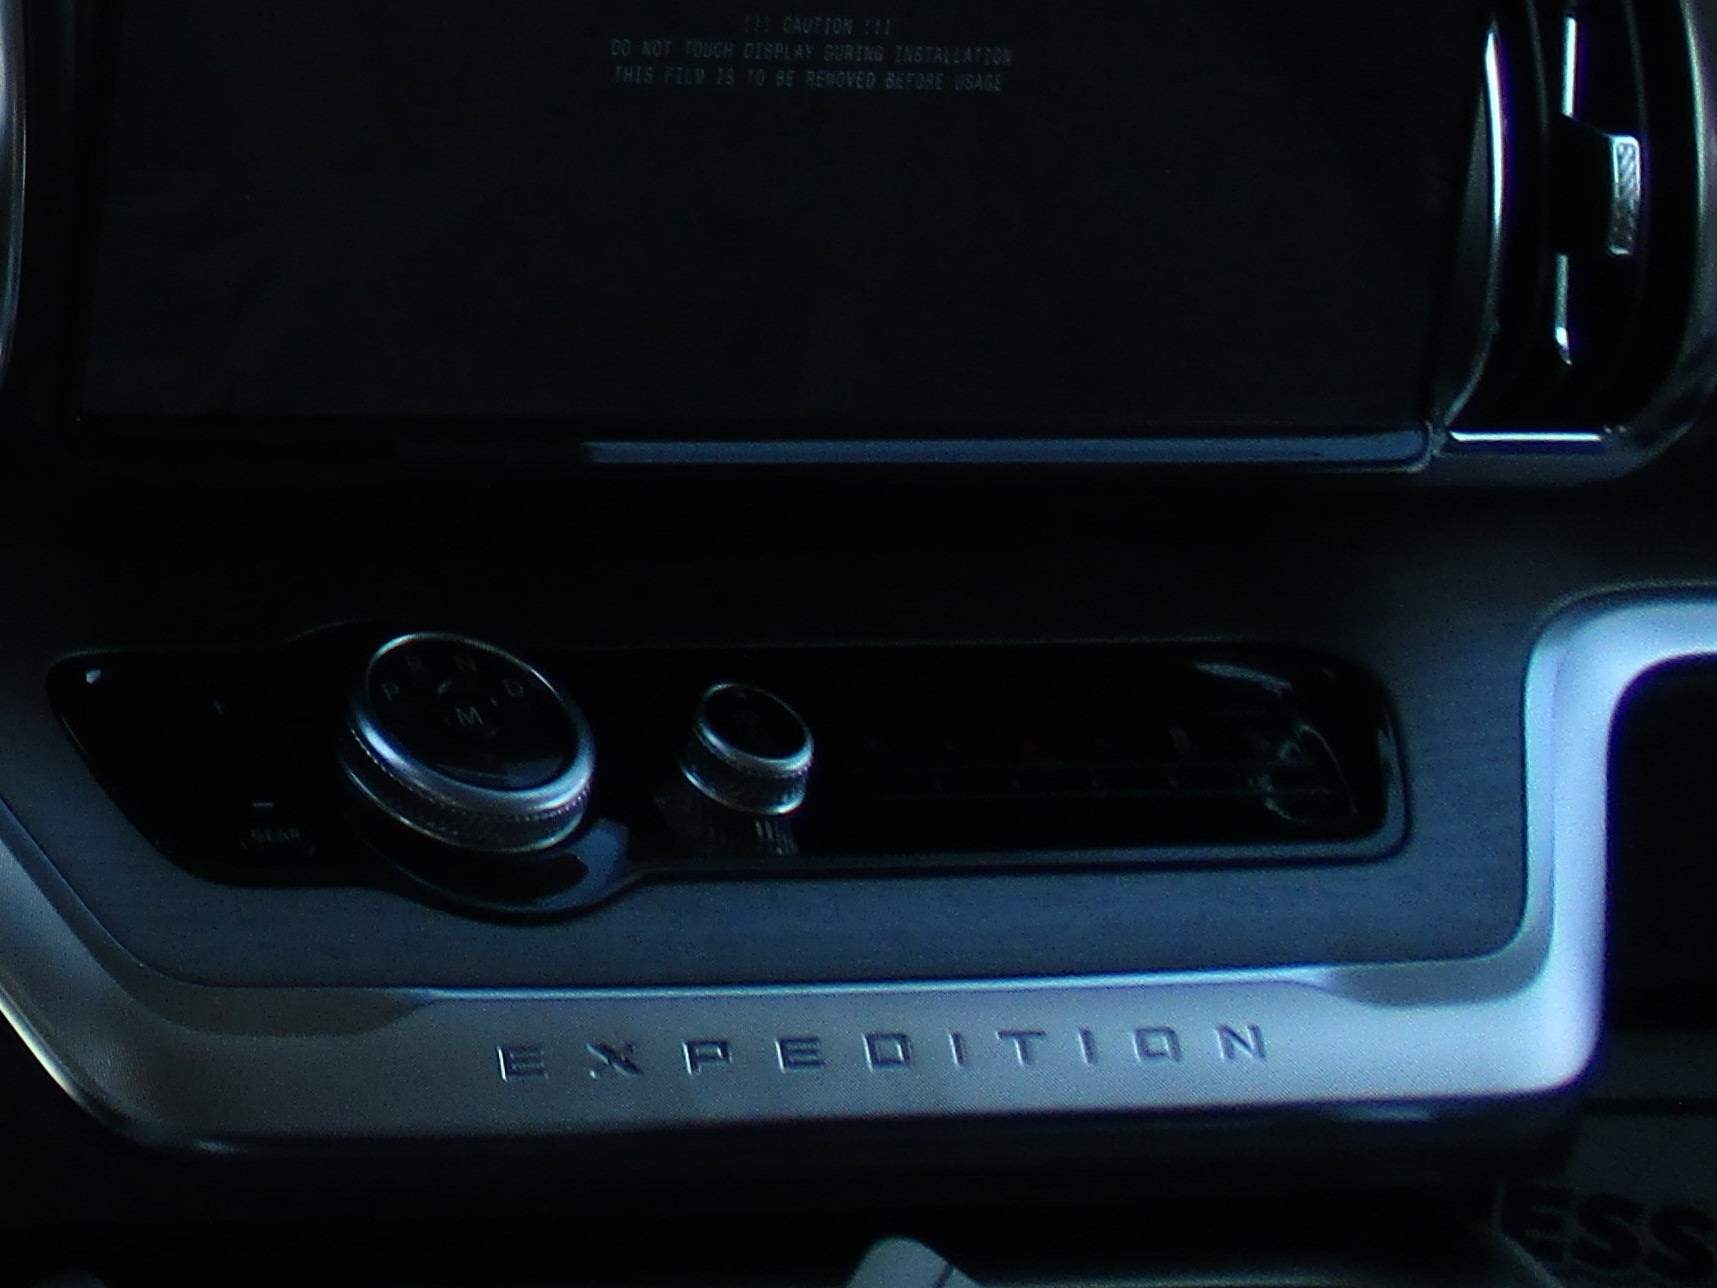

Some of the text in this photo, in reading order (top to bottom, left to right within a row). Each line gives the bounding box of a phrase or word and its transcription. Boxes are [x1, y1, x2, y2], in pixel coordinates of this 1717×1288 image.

[781, 14, 854, 35] CAUTION
[610, 37, 1013, 66] DO NOT TOUCH DISPLAY DURING INSTALLATION
[613, 64, 1003, 92] THIS FILM IS TO BE REMOVED BEFORE USAGE
[455, 705, 484, 727] M
[495, 1023, 1269, 1084] EXPEDITION
